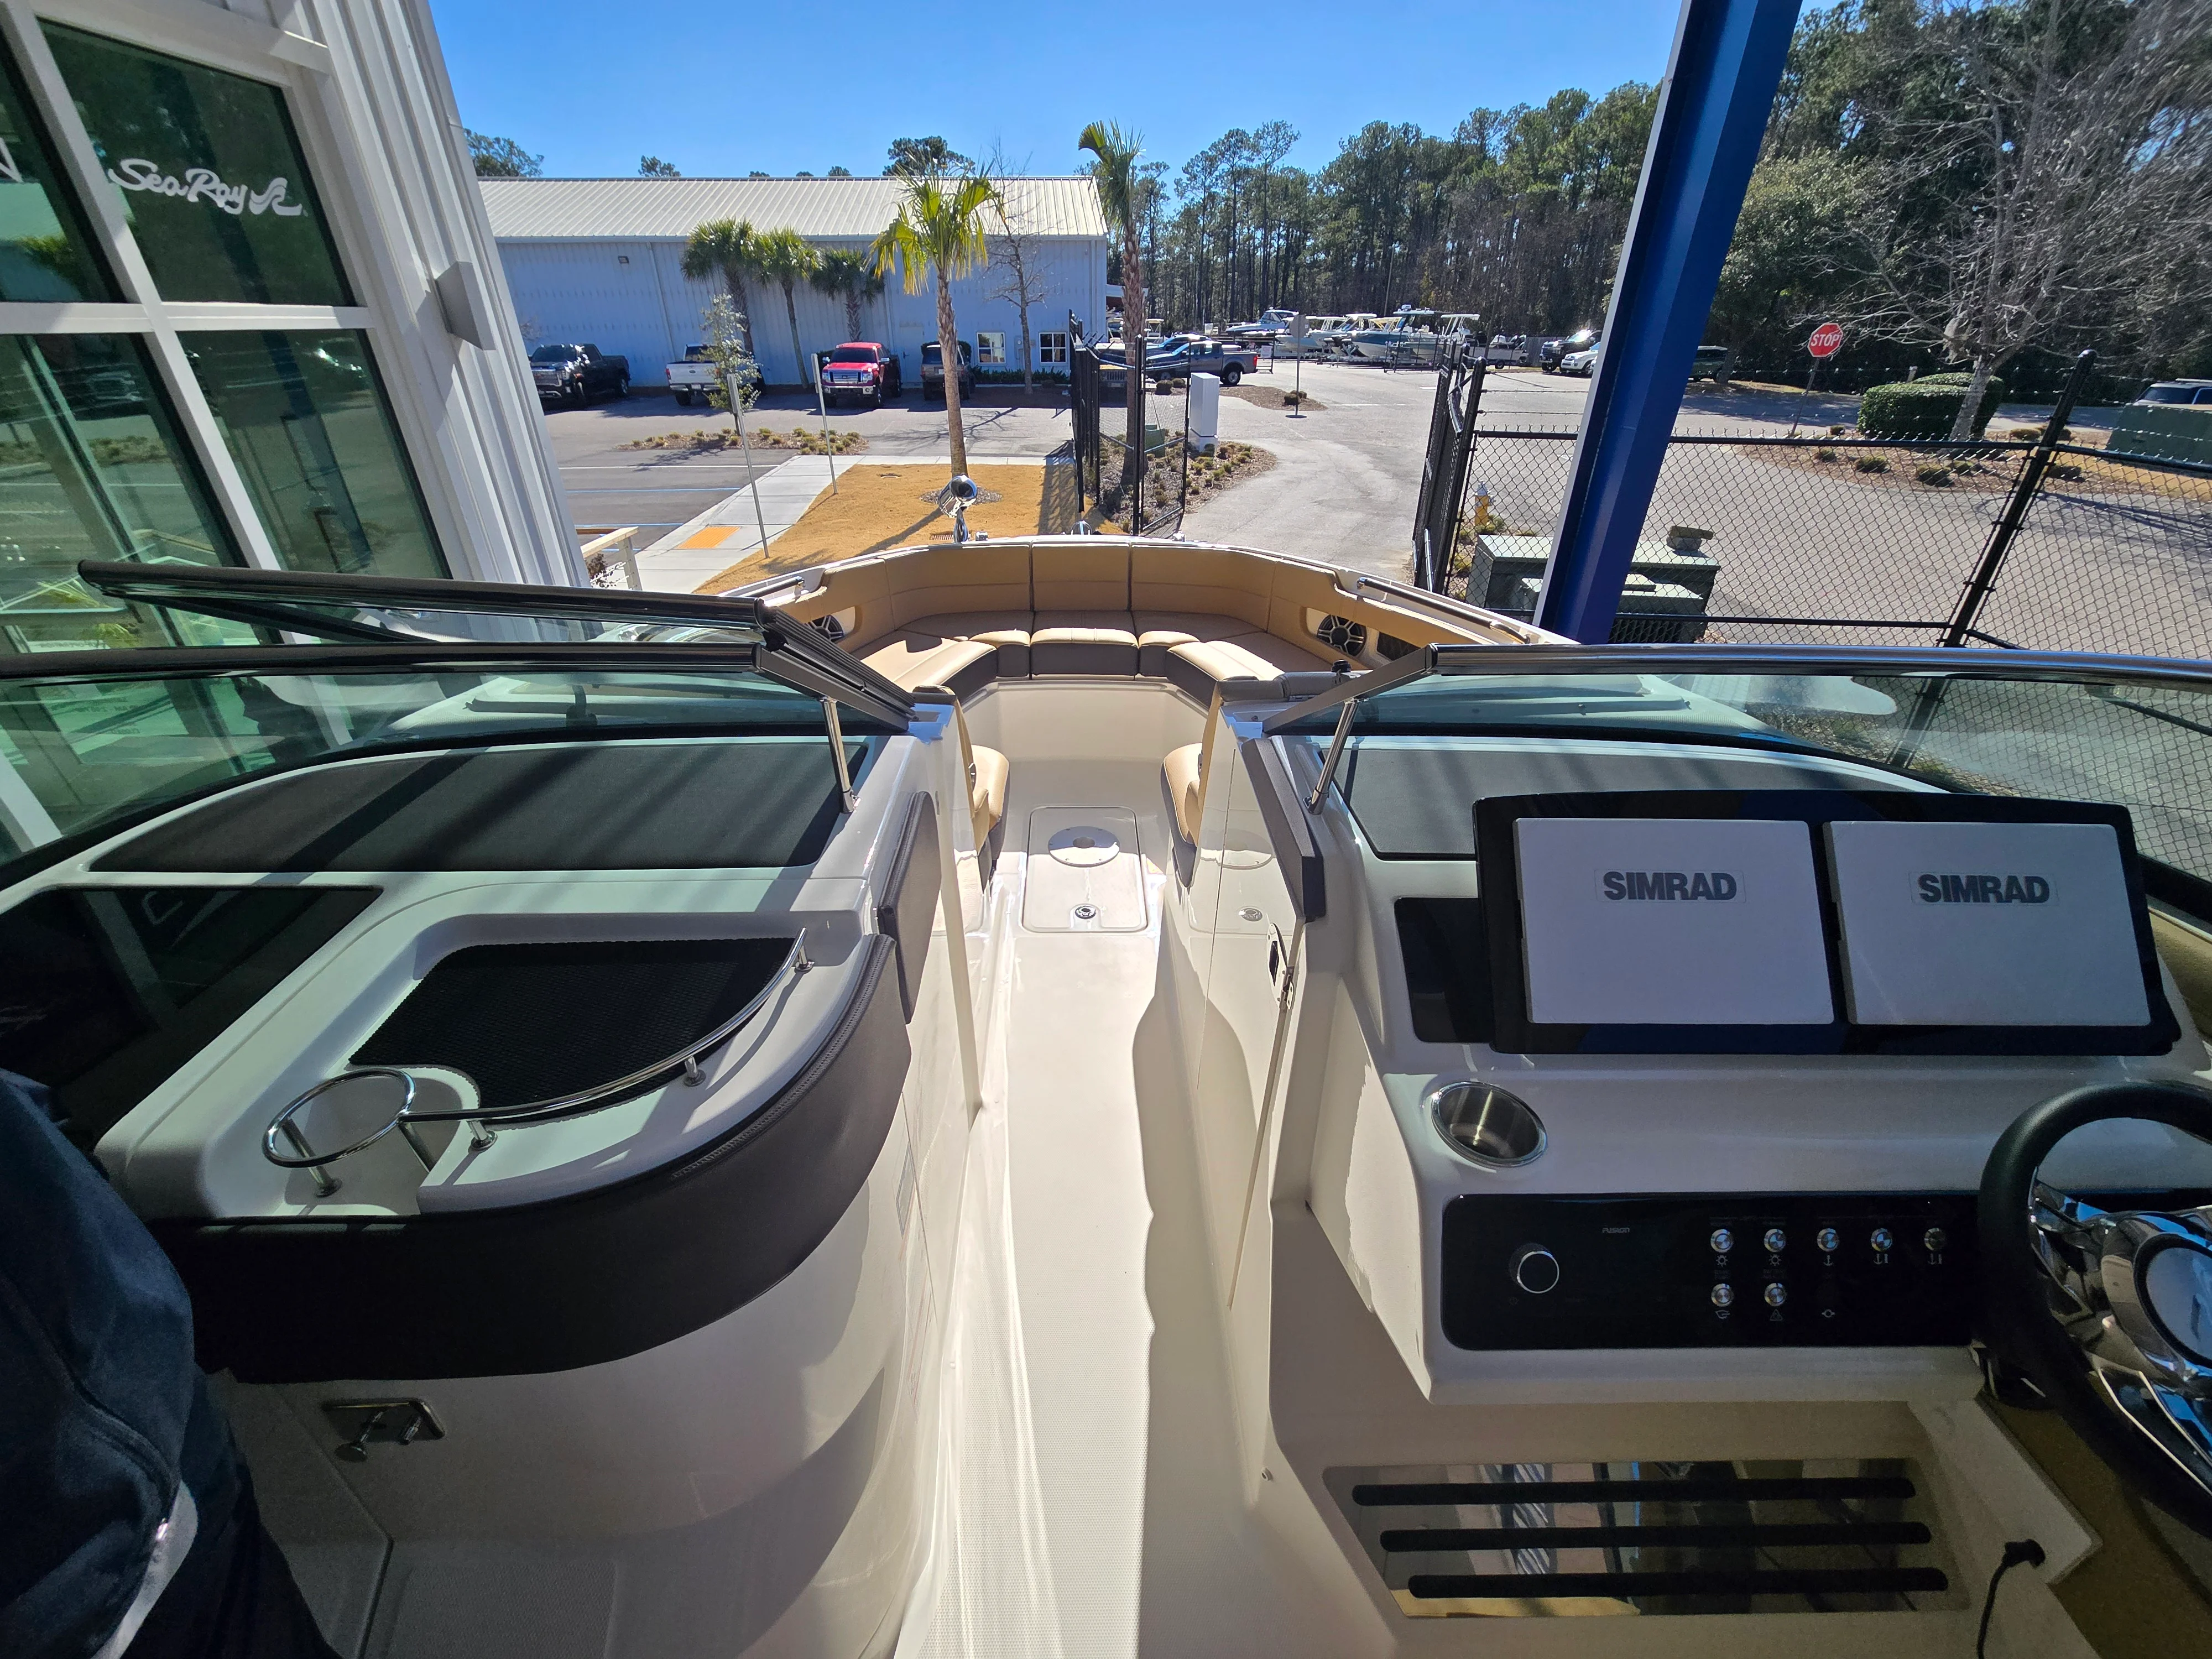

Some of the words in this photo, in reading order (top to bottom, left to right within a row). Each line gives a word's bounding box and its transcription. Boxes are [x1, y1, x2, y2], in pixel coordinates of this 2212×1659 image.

[1811, 333, 1839, 346] STOP
[1603, 871, 1737, 900] SIMRAD
[1918, 874, 2049, 903] SIMRAD
